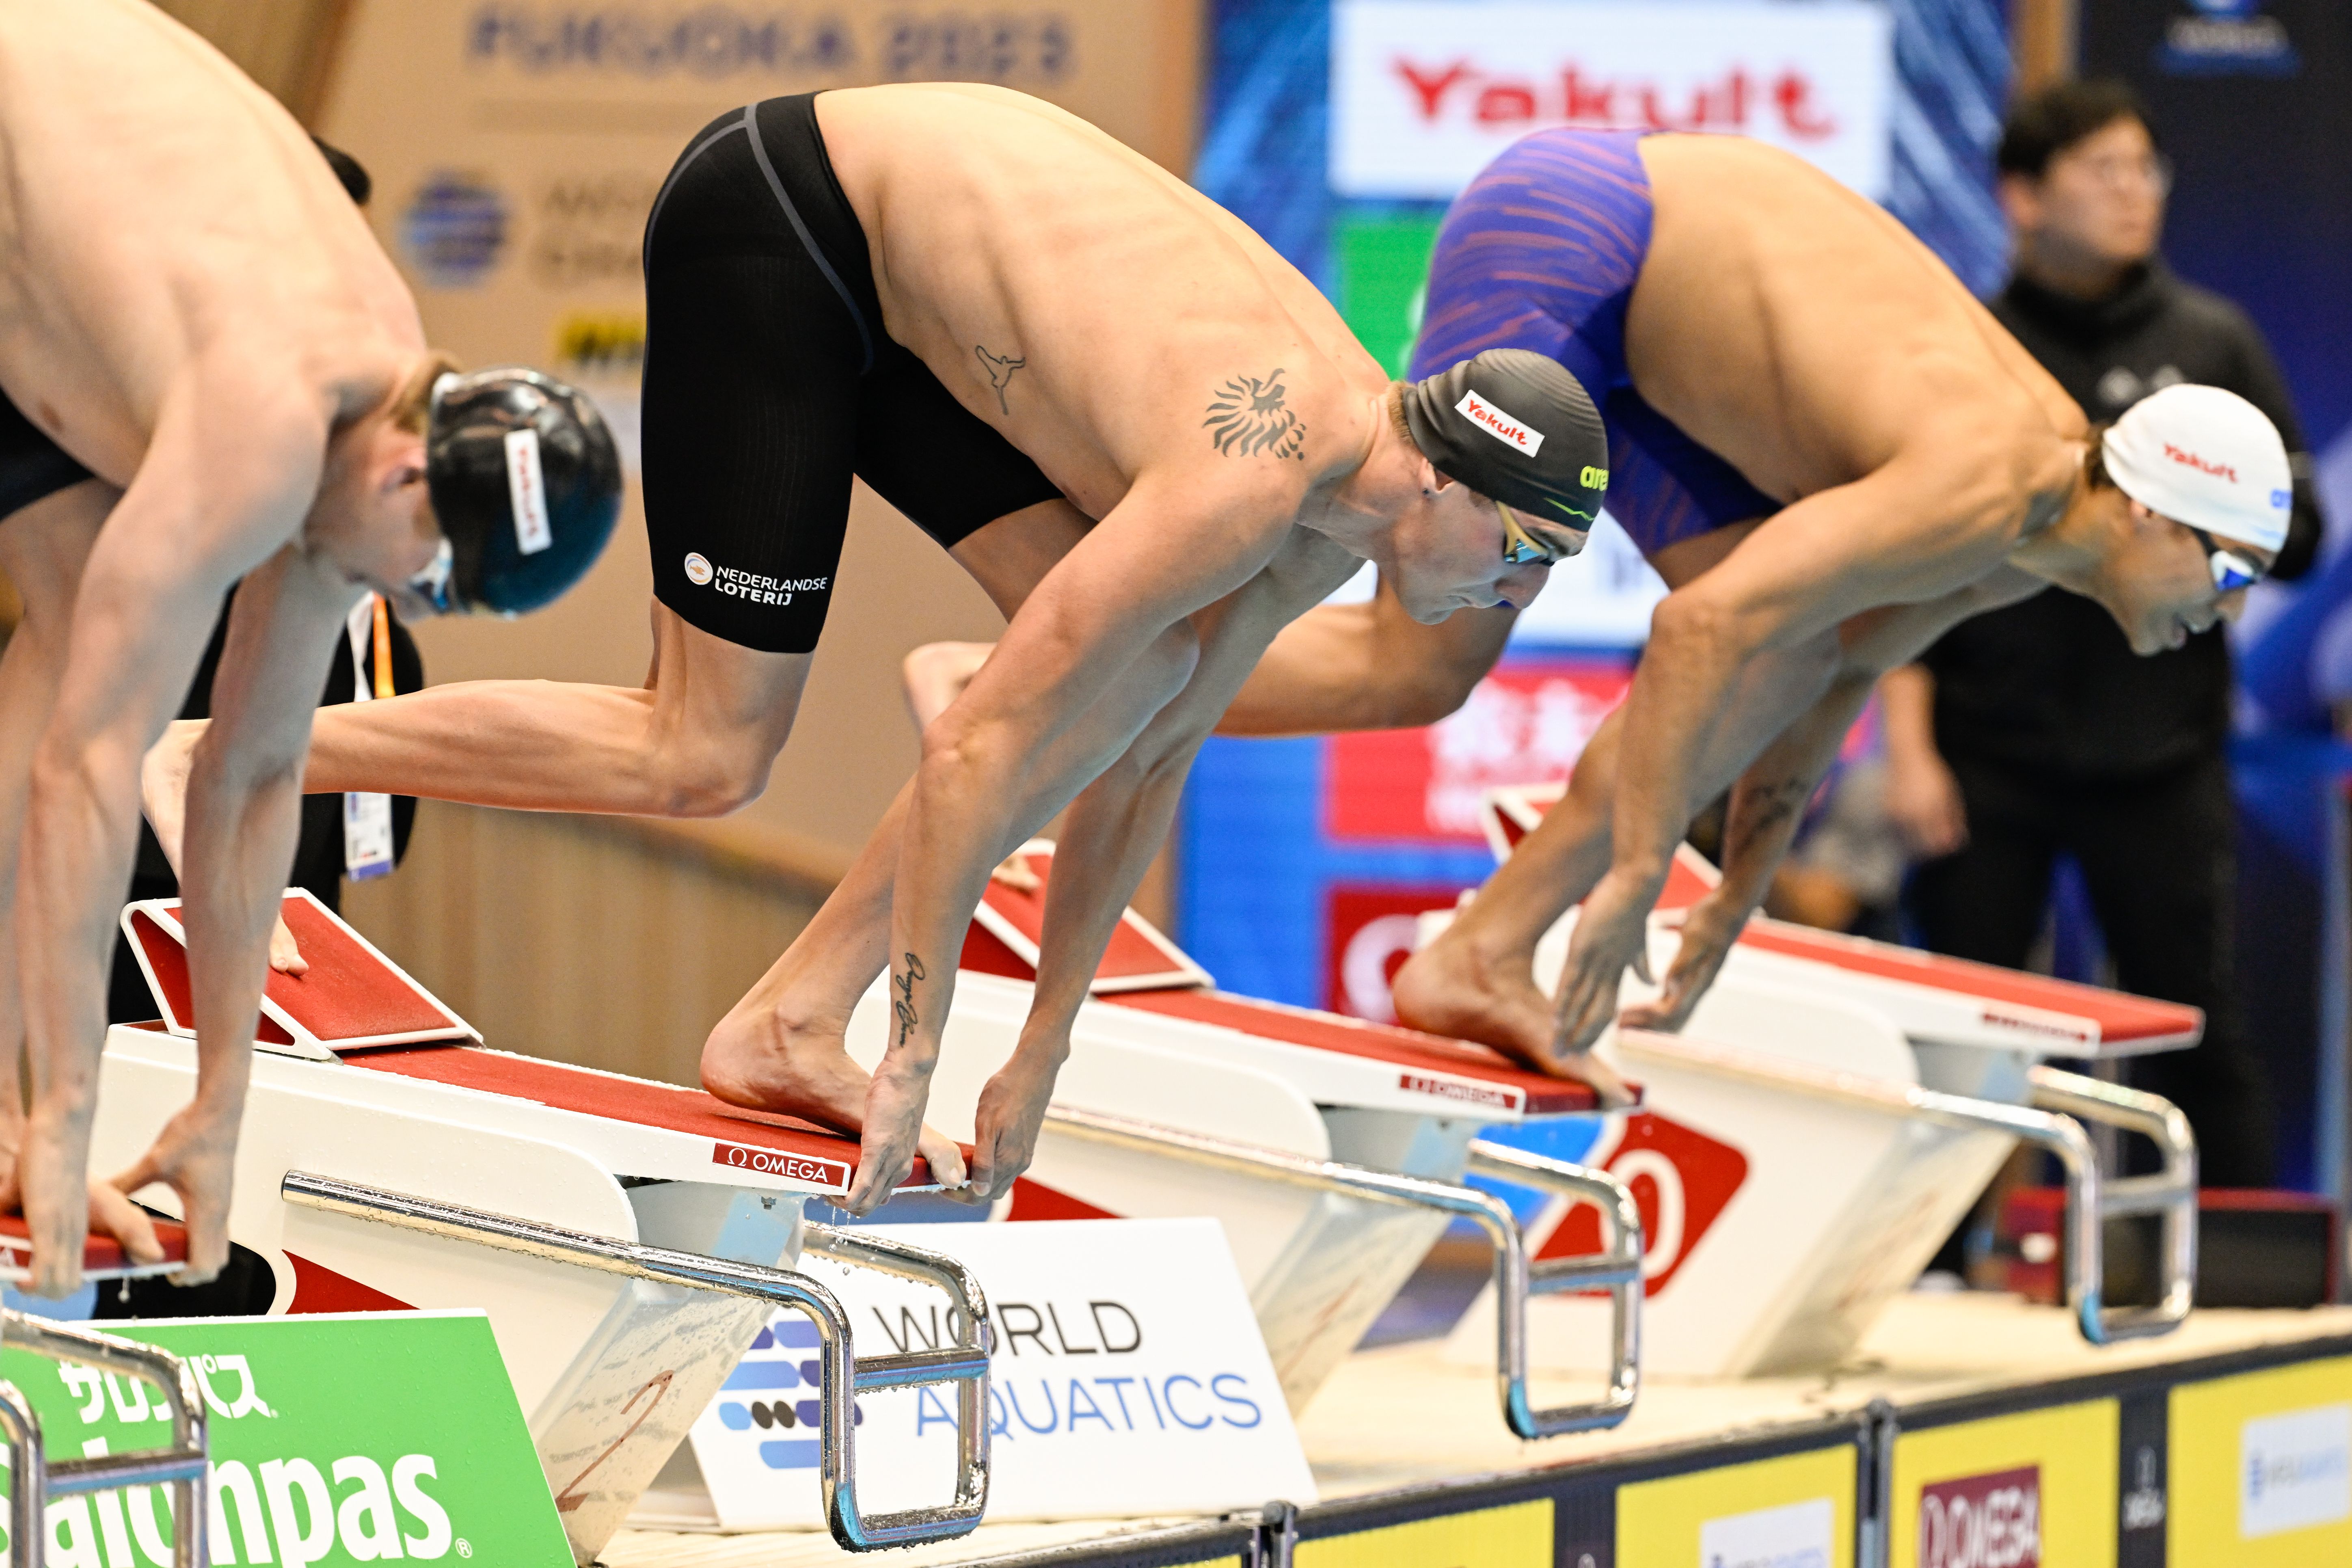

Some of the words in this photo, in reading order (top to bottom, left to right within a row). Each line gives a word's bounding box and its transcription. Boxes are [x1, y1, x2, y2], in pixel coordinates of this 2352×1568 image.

[1393, 58, 1837, 139] Yakult
[1468, 399, 1527, 445] Yakult
[2164, 443, 2238, 483] Yakult
[715, 578, 793, 606] LOTERIJ
[717, 566, 828, 592] NEDERLANDSE
[753, 1153, 828, 1183] OMEGA
